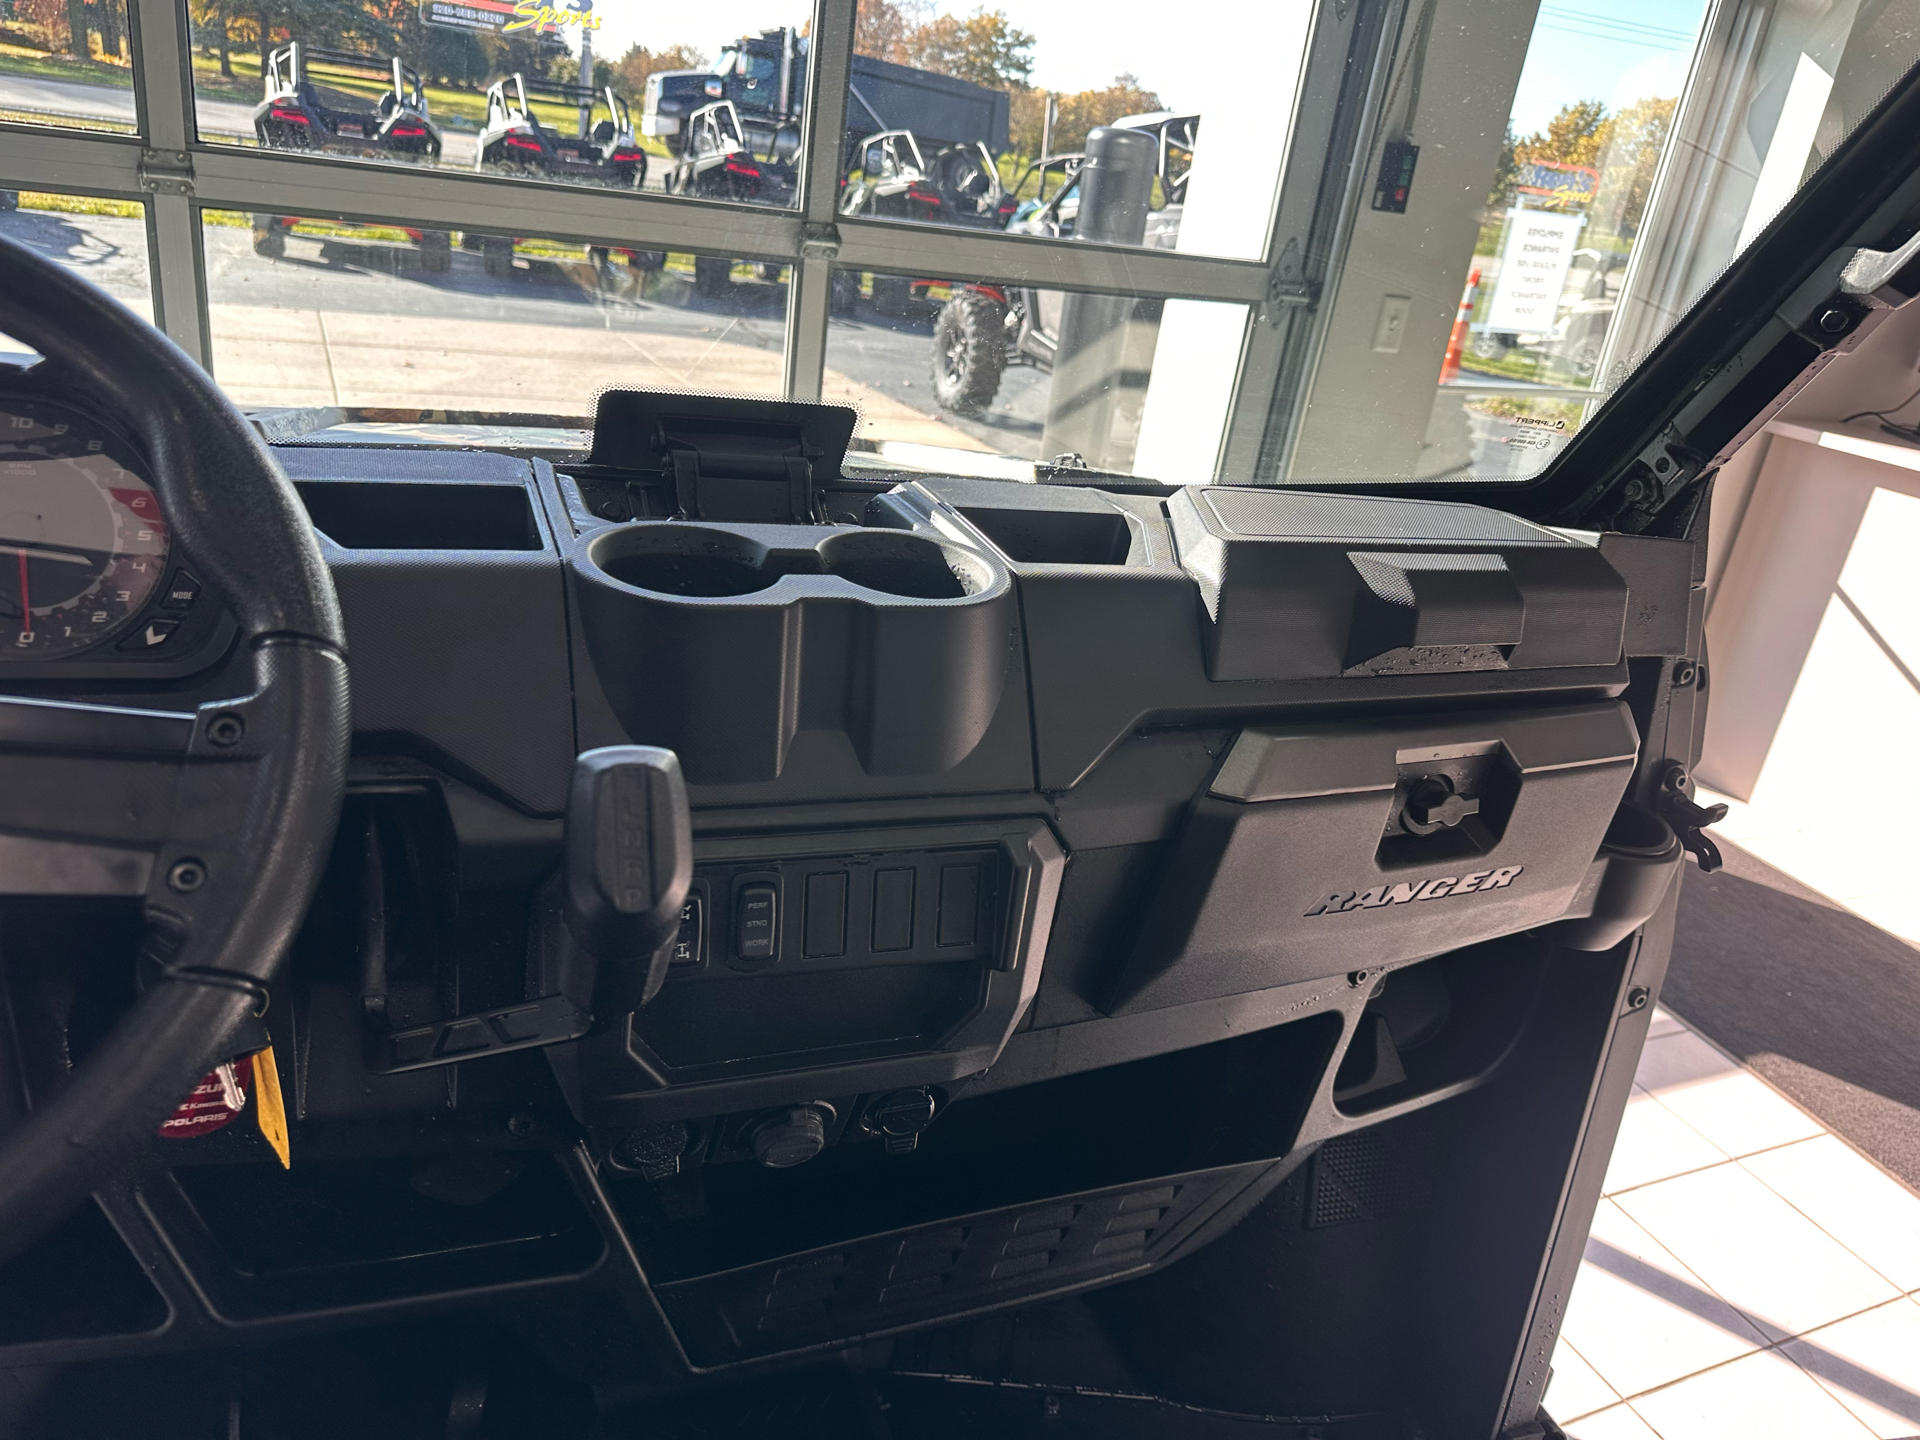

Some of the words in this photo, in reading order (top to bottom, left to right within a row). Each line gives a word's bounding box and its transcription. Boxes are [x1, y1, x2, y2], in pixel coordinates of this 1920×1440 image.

[502, 0, 602, 35] Sports
[1544, 185, 1594, 207] Sports
[10, 416, 34, 429] 10
[131, 497, 148, 508] 6
[137, 530, 153, 541] 5
[132, 562, 147, 573] 4
[115, 591, 131, 602] 3
[172, 591, 193, 600] MODE
[92, 611, 107, 623] 2
[64, 626, 72, 637] 1
[1303, 864, 1524, 917] RANGER
[747, 901, 769, 910] PERF
[746, 919, 768, 928] STND
[163, 1113, 229, 1128] POLARIS
